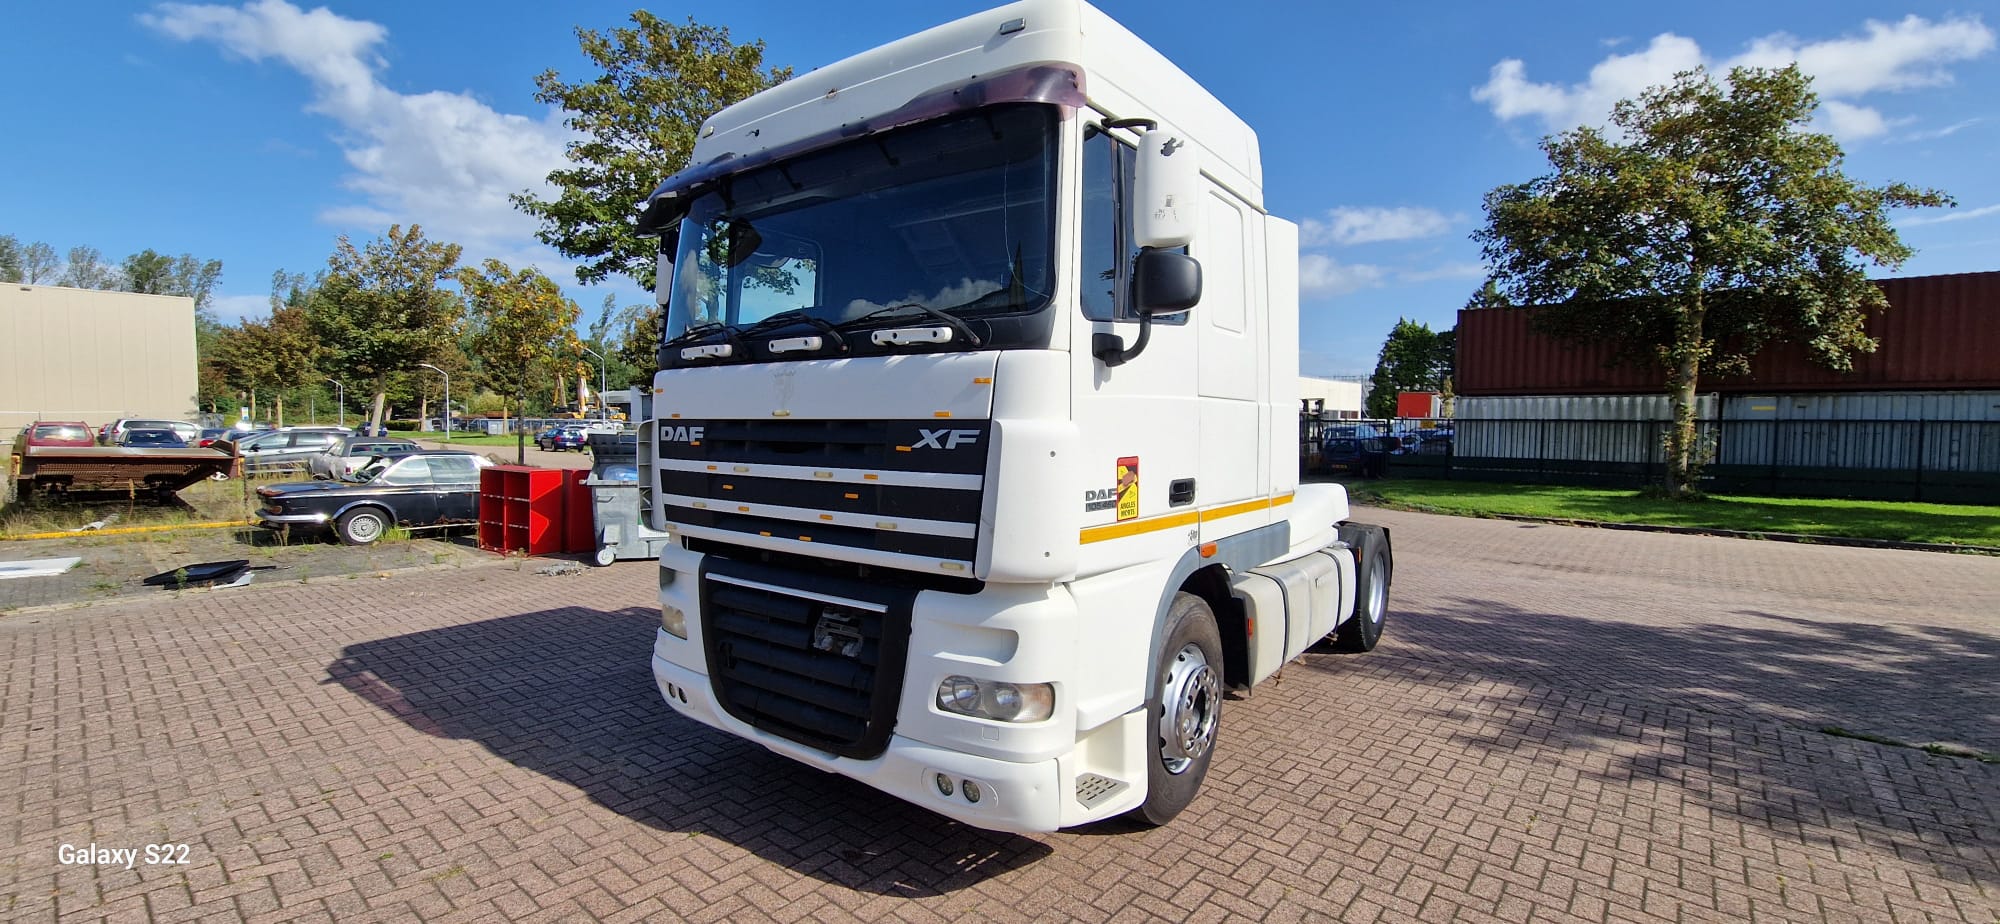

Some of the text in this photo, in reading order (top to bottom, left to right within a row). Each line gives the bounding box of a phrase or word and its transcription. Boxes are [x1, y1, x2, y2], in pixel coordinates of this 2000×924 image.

[660, 426, 704, 442] DAF
[911, 429, 981, 449] XF
[1085, 488, 1117, 501] DAF
